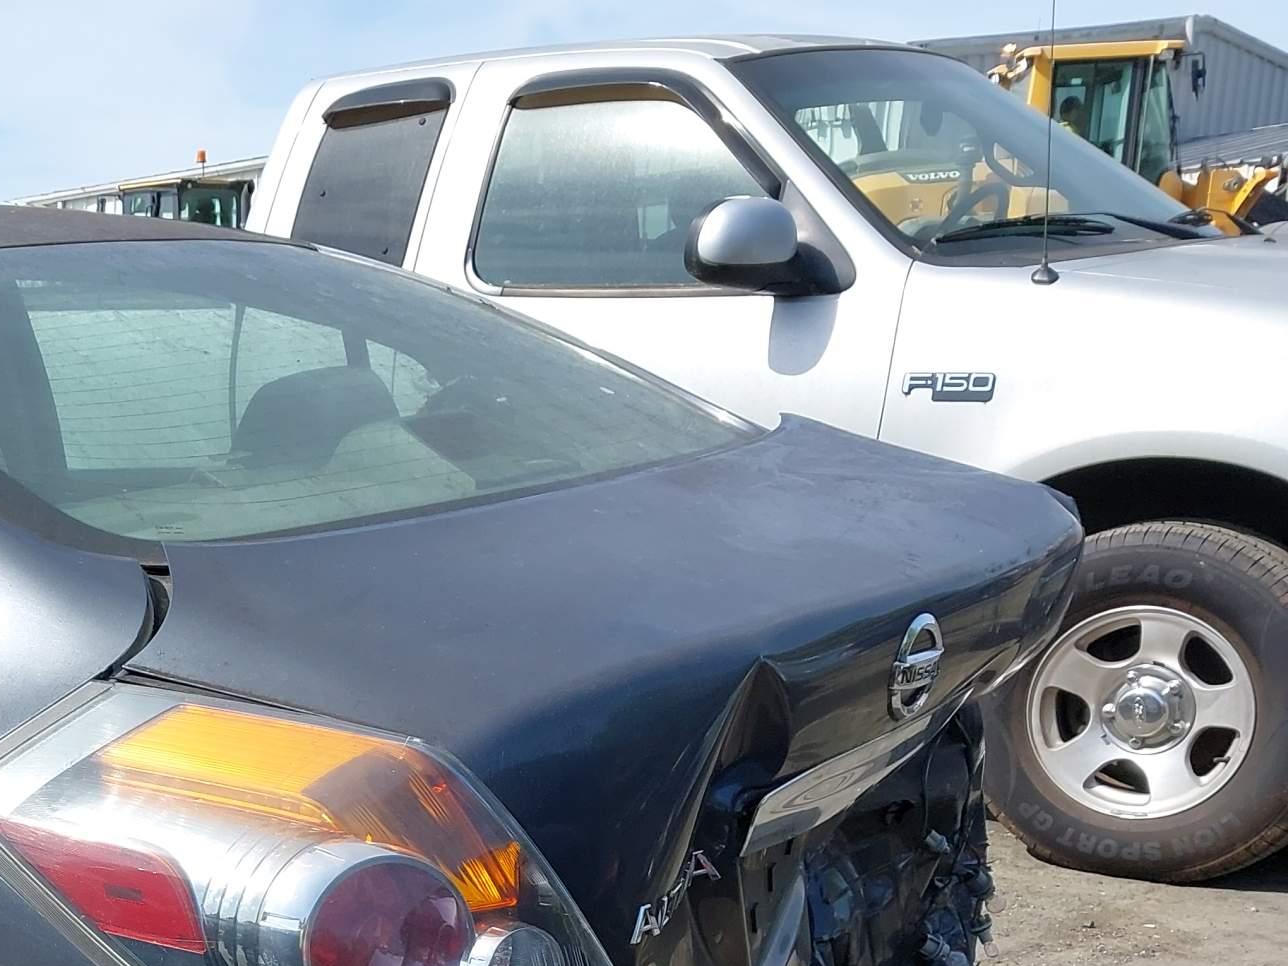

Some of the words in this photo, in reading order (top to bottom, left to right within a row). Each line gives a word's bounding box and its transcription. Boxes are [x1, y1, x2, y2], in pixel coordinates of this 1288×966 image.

[907, 170, 961, 181] VOLVO
[900, 662, 939, 685] NISS
[1018, 801, 1054, 832] GP
[1056, 827, 1161, 861] SPORT
